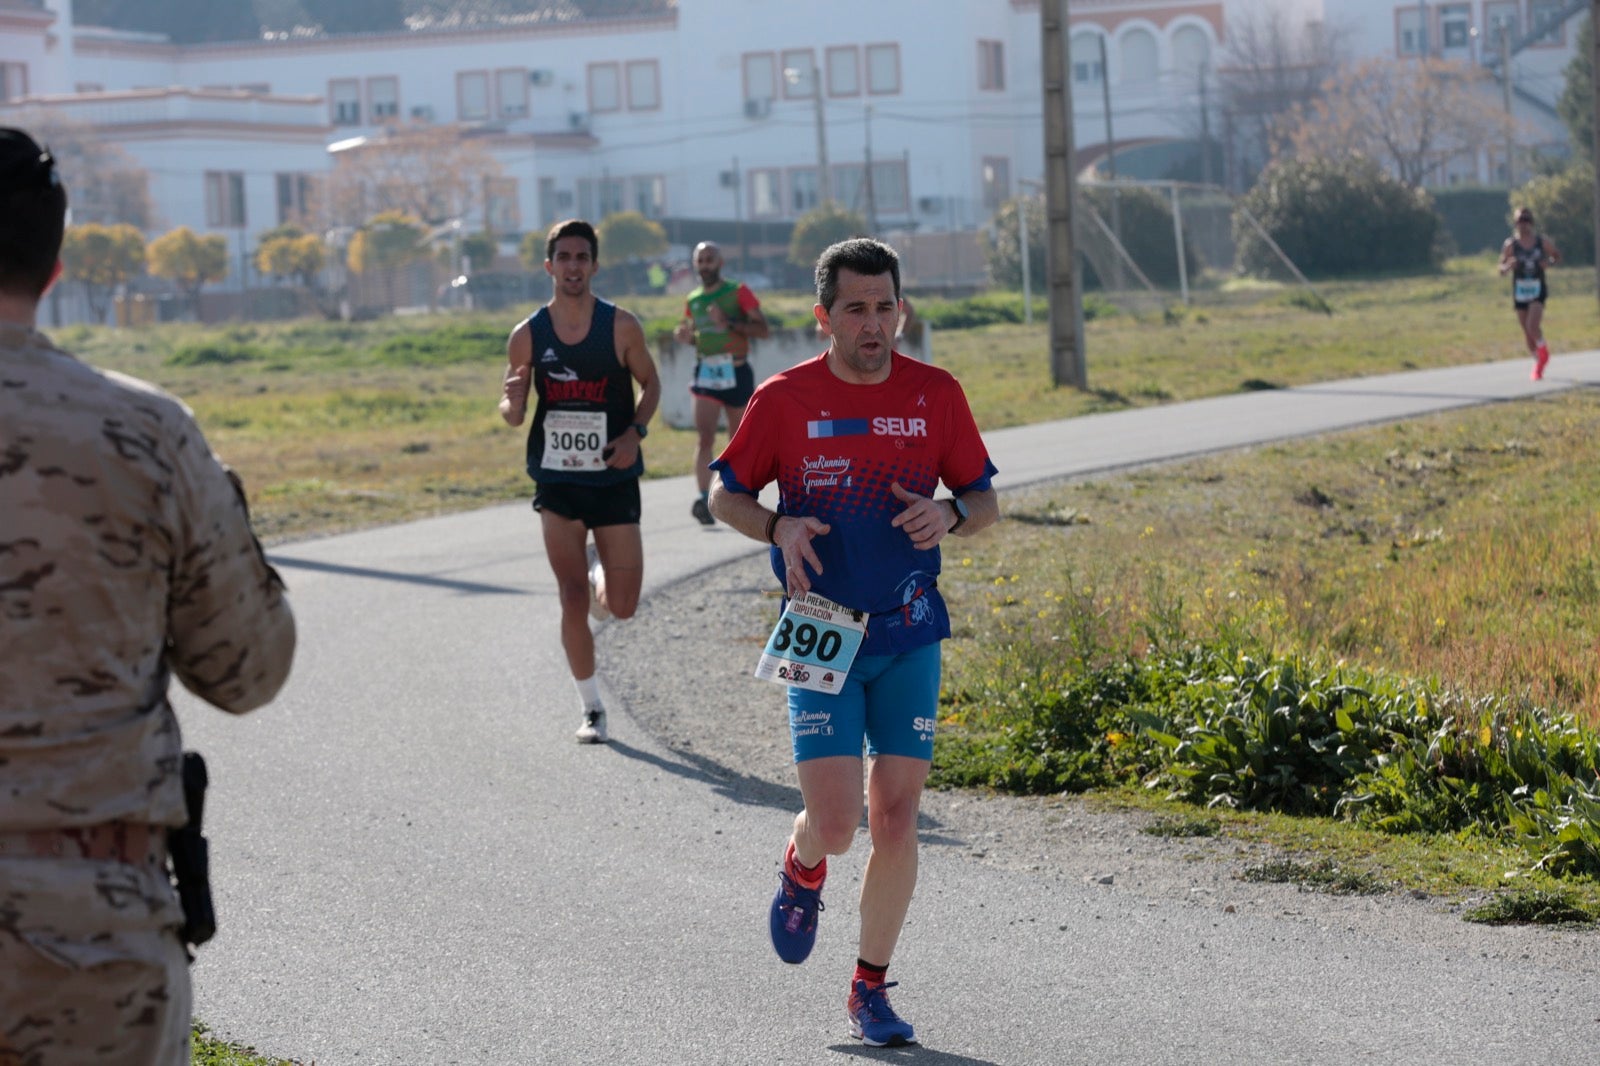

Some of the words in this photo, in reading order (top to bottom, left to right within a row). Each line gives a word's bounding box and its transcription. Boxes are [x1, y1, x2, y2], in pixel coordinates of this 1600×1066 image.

[872, 416, 928, 437] SEUR
[551, 430, 600, 452] 3060
[803, 470, 838, 494] Granada
[807, 595, 831, 611] PREMIO
[831, 603, 842, 613] DE
[773, 617, 842, 662] 890
